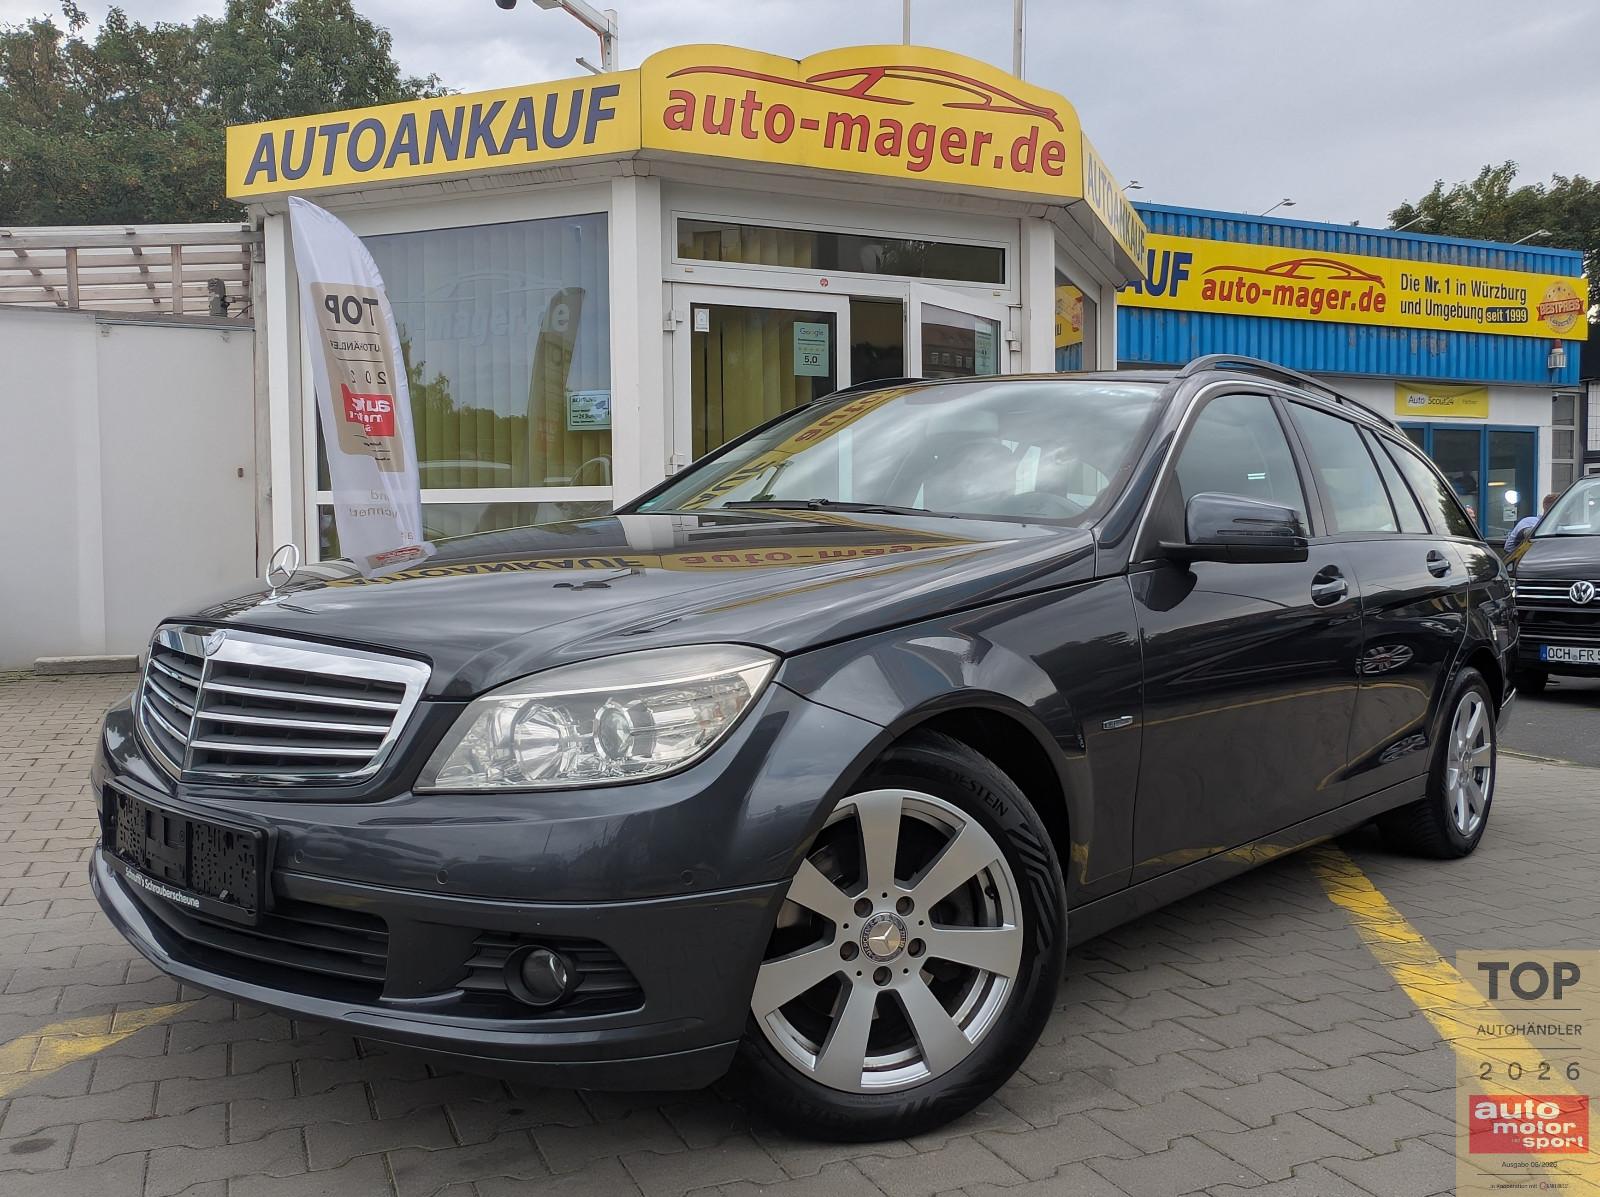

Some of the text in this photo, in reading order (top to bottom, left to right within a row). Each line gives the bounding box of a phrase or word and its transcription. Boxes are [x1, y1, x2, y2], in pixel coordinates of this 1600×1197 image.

[244, 84, 621, 186] AUTOANKAUF
[663, 89, 1066, 177] auto-mager.de
[1087, 151, 1145, 267] AUTOANKAUF
[1202, 277, 1387, 314] auto-mager.de
[1401, 273, 1527, 305] Die Nr. 1 in Würzburg
[1400, 299, 1527, 323] und Umgebung seit 1999
[1548, 647, 1570, 660] OCH
[1579, 649, 1594, 661] FR
